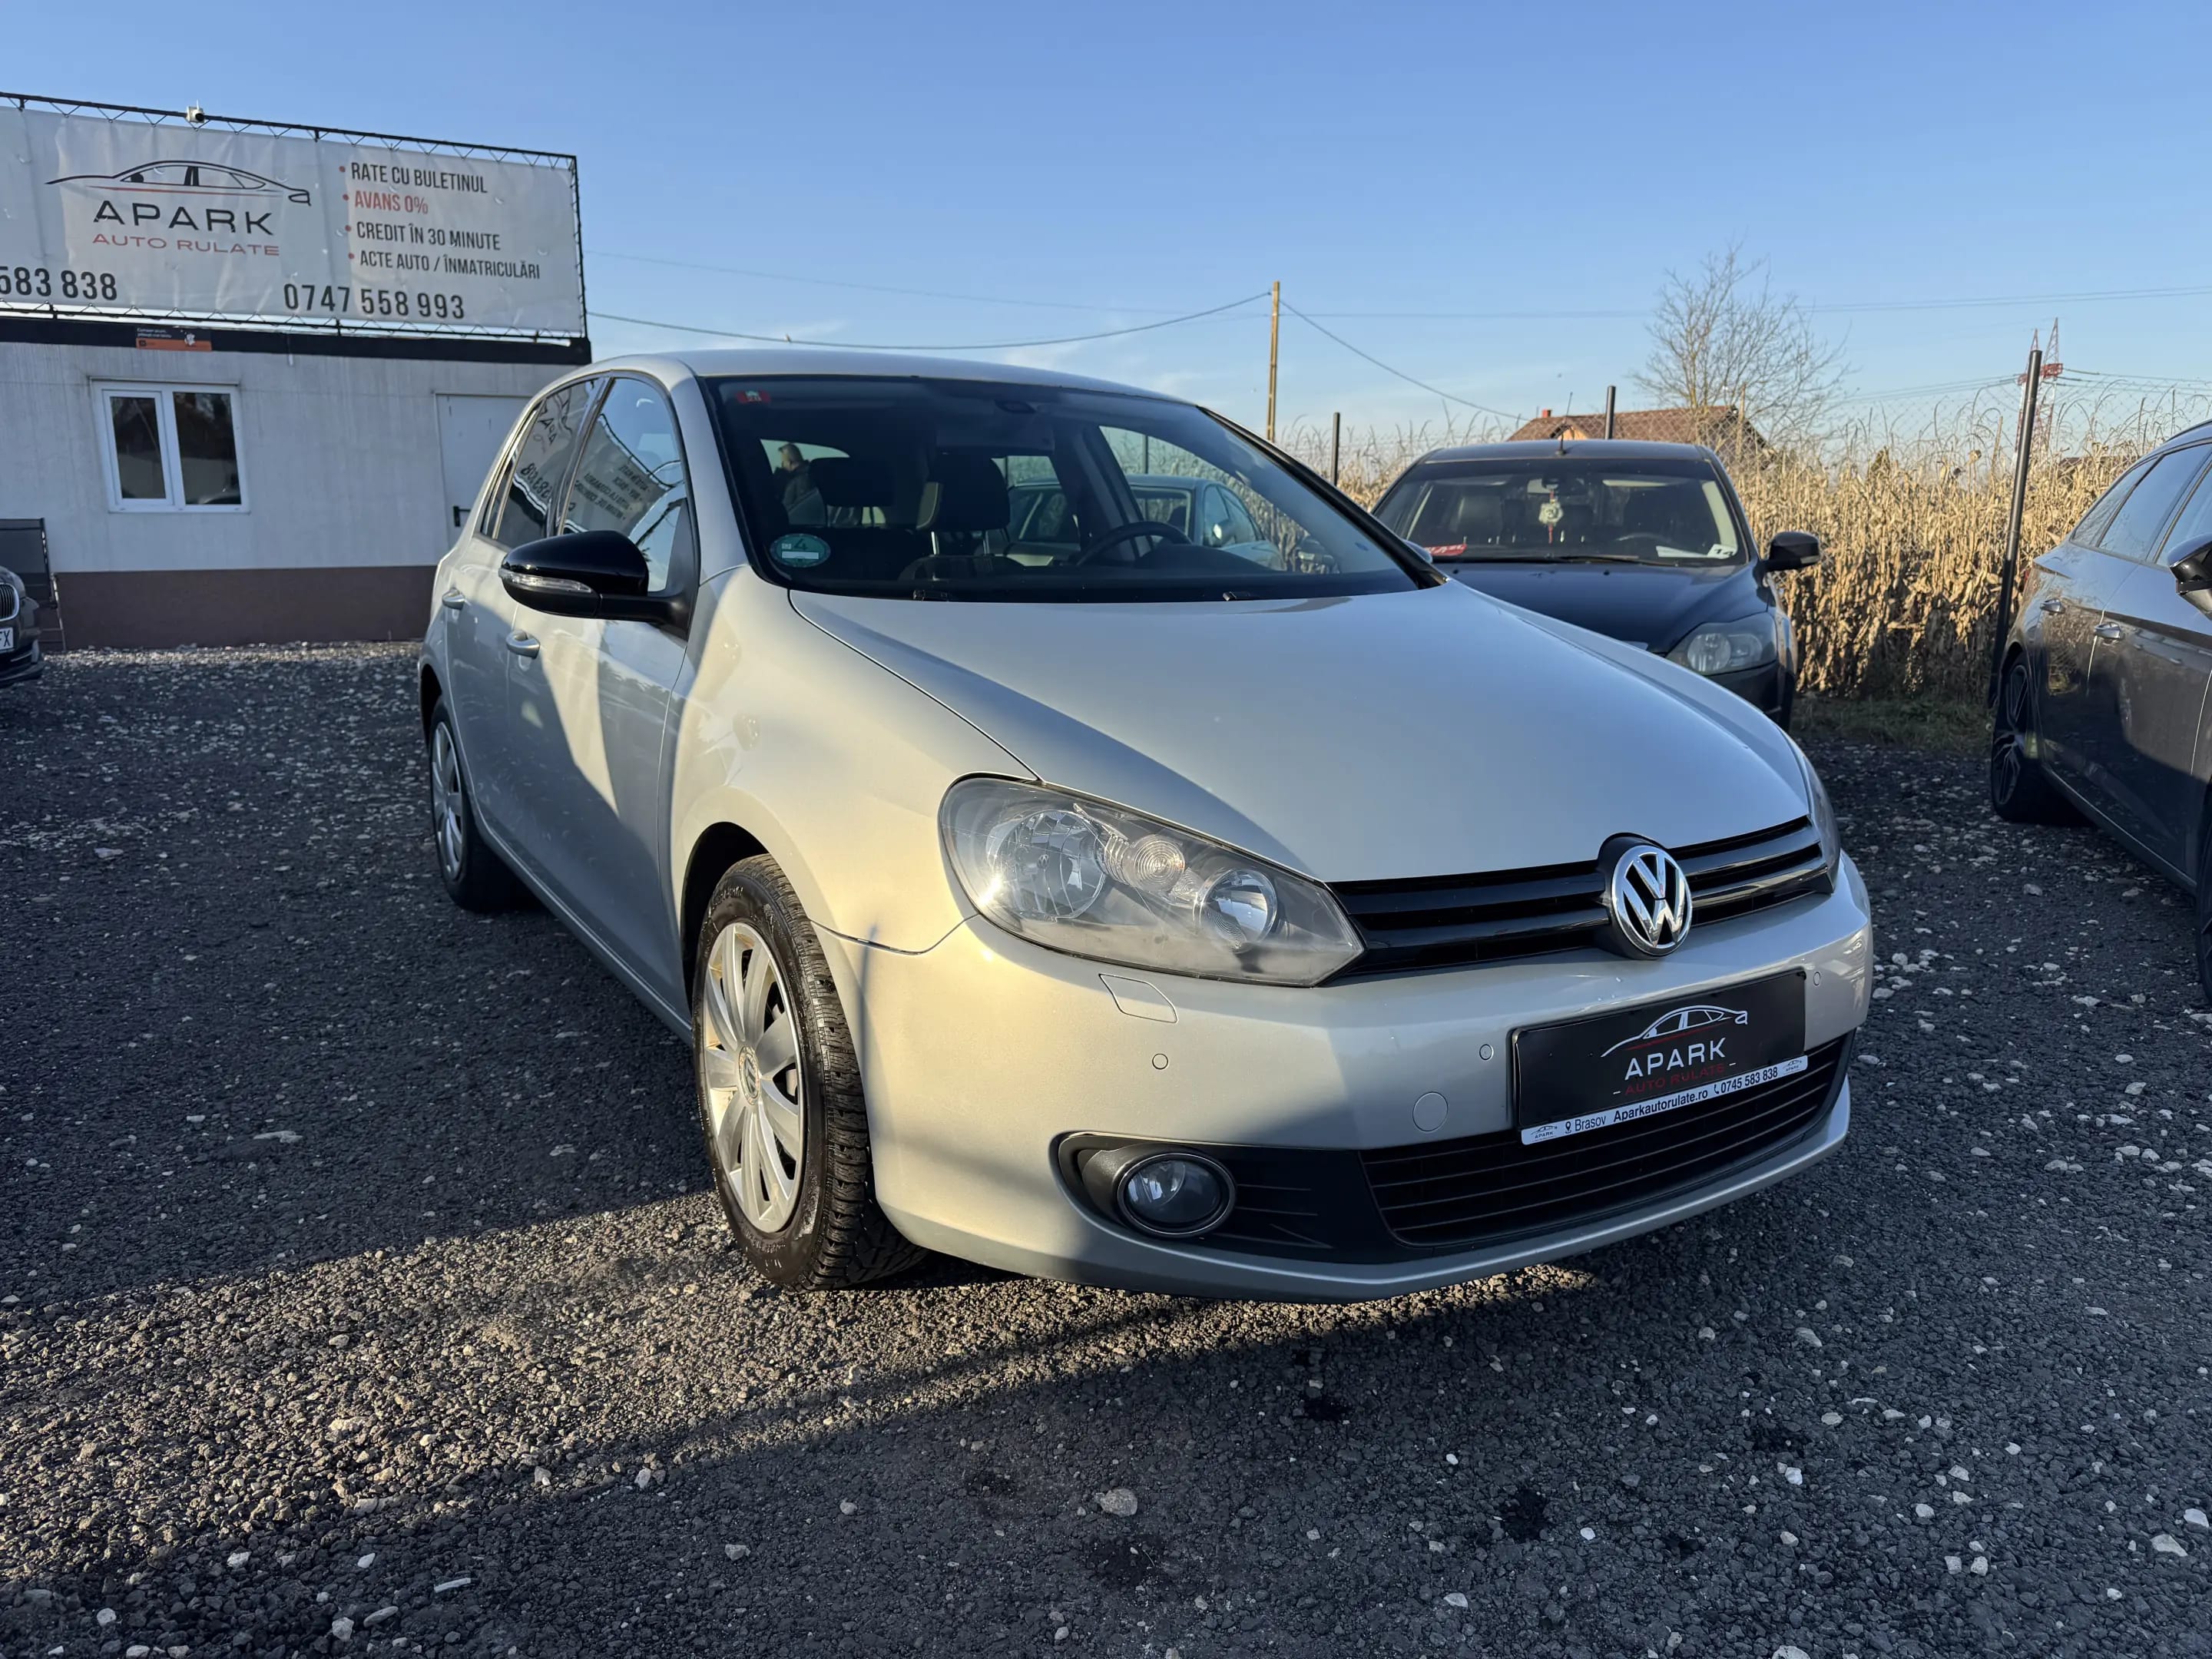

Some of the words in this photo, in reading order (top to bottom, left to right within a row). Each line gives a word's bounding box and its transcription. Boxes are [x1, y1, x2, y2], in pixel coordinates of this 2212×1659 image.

[352, 161, 387, 184] RATE
[392, 166, 409, 185] CU
[415, 171, 488, 194] BULETINUL
[93, 200, 273, 235] APARK
[355, 190, 401, 211] AVANS
[405, 195, 429, 215] 0%
[92, 233, 167, 250] AUTO
[177, 240, 280, 257] RULATE
[356, 220, 406, 243] CREDIT
[409, 222, 424, 245] ÎN
[428, 228, 445, 246] 30
[449, 230, 501, 251] MINUTE
[359, 250, 393, 270] ACTE
[396, 255, 430, 272] AUTO
[444, 254, 541, 280] ÎNMATRICULĂRI
[0, 265, 51, 297] 583
[61, 270, 118, 301] 838
[283, 283, 350, 313] 0747
[360, 288, 409, 316] 558
[417, 292, 465, 320] 993
[793, 538, 808, 551] 4
[1614, 847, 1690, 952] VW
[1624, 1037, 1726, 1081] APARK
[1625, 1077, 1667, 1095] AUTO
[1671, 1063, 1726, 1085] RULATE
[1575, 1115, 1607, 1131] Brasov
[1613, 1088, 1709, 1124] Aparkautorulate.ro
[1720, 1077, 1742, 1094] 0745
[1744, 1071, 1760, 1087] 583
[1762, 1066, 1779, 1081] 838
